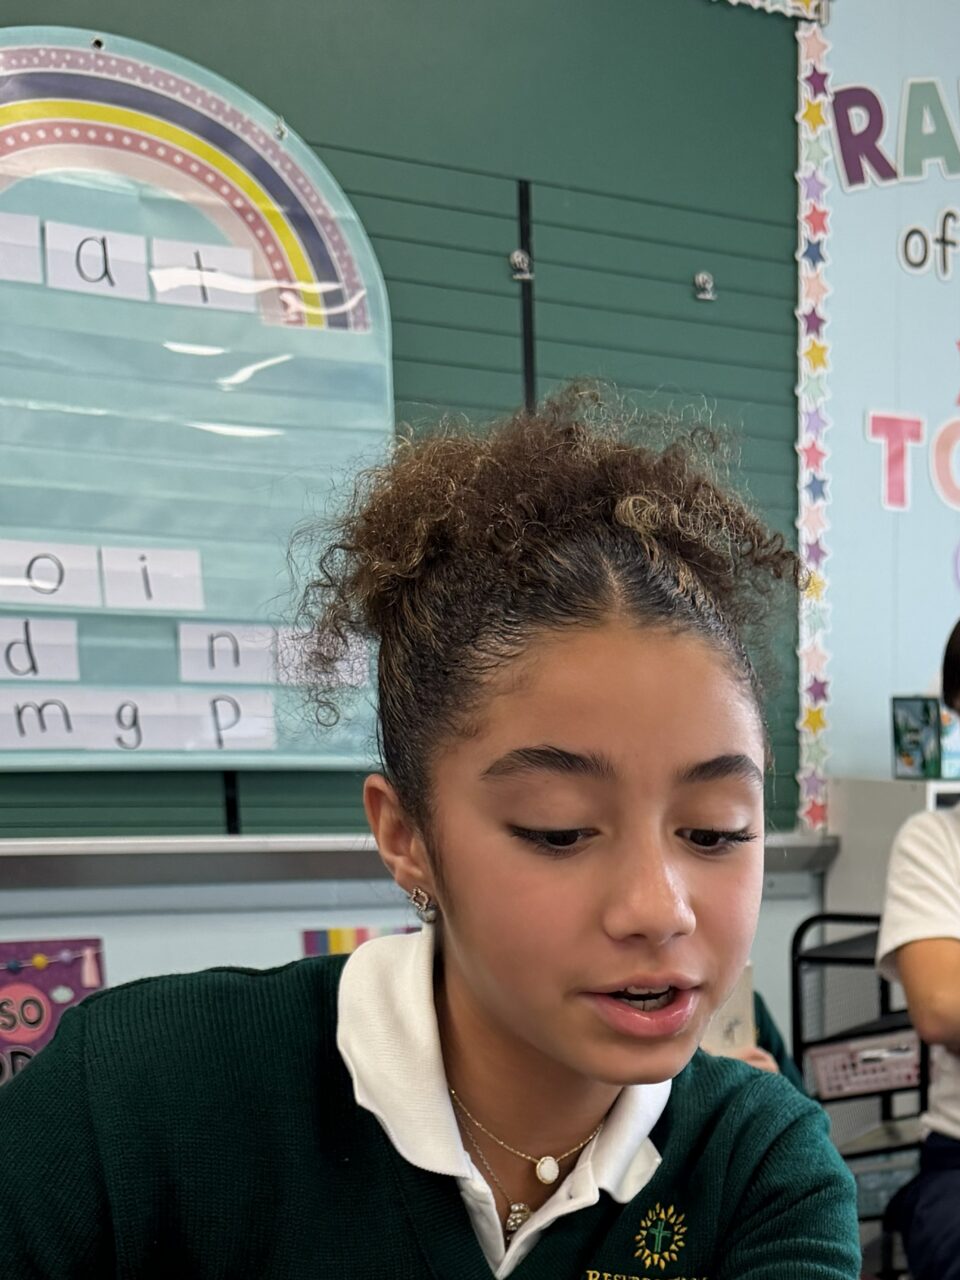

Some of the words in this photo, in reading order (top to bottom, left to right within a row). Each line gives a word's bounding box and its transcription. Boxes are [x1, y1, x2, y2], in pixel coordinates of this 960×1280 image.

[75, 236, 116, 287] a
[903, 211, 959, 275] of
[25, 553, 65, 595] o
[138, 554, 153, 601] i
[5, 619, 39, 676] d
[207, 631, 241, 670] n
[15, 698, 73, 737] m
[115, 700, 143, 750] g
[209, 694, 242, 749] p
